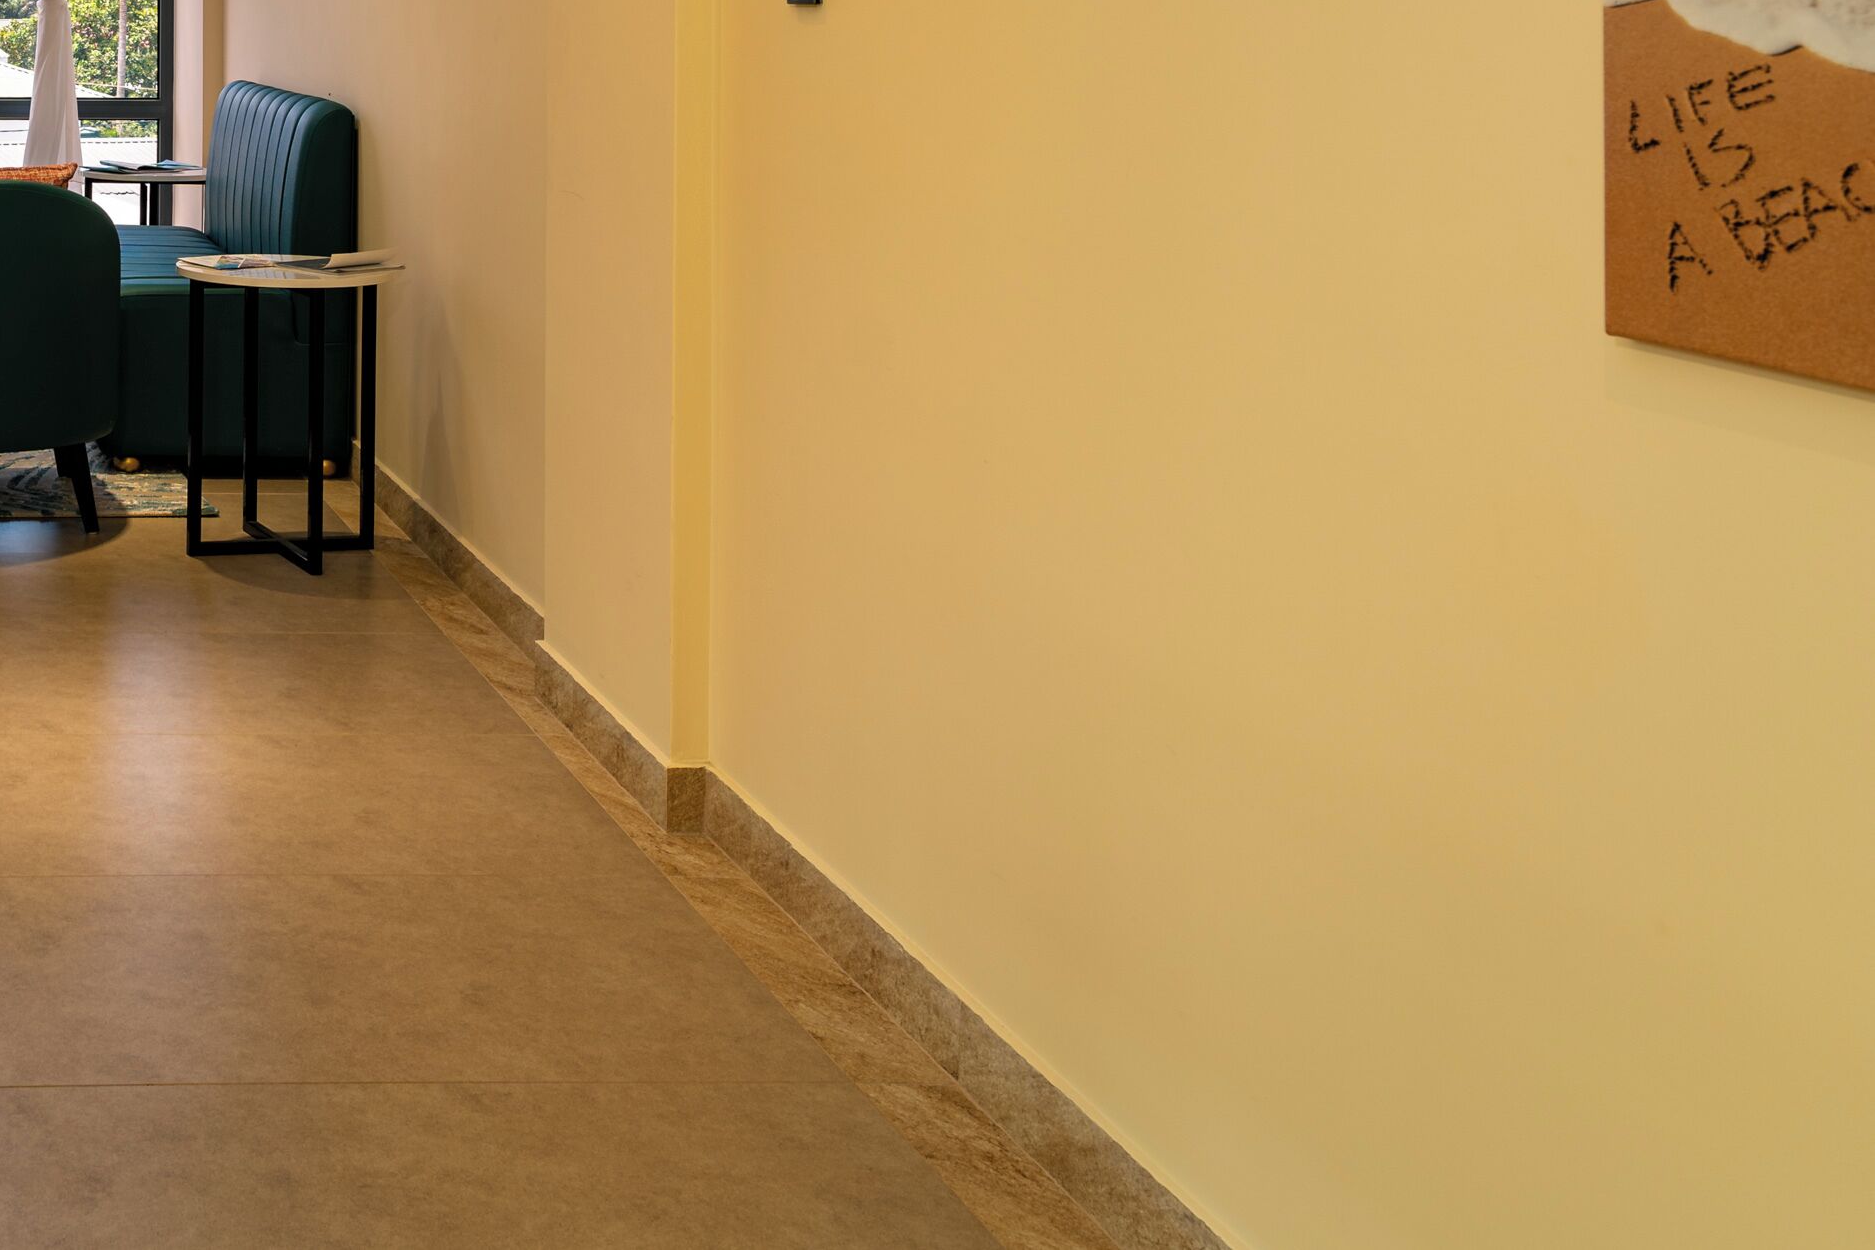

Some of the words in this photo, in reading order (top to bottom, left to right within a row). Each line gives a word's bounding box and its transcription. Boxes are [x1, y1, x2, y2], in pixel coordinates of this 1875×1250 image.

[1628, 63, 1776, 154] LIFE
[1683, 128, 1756, 191] IS
[1667, 221, 1714, 293] A
